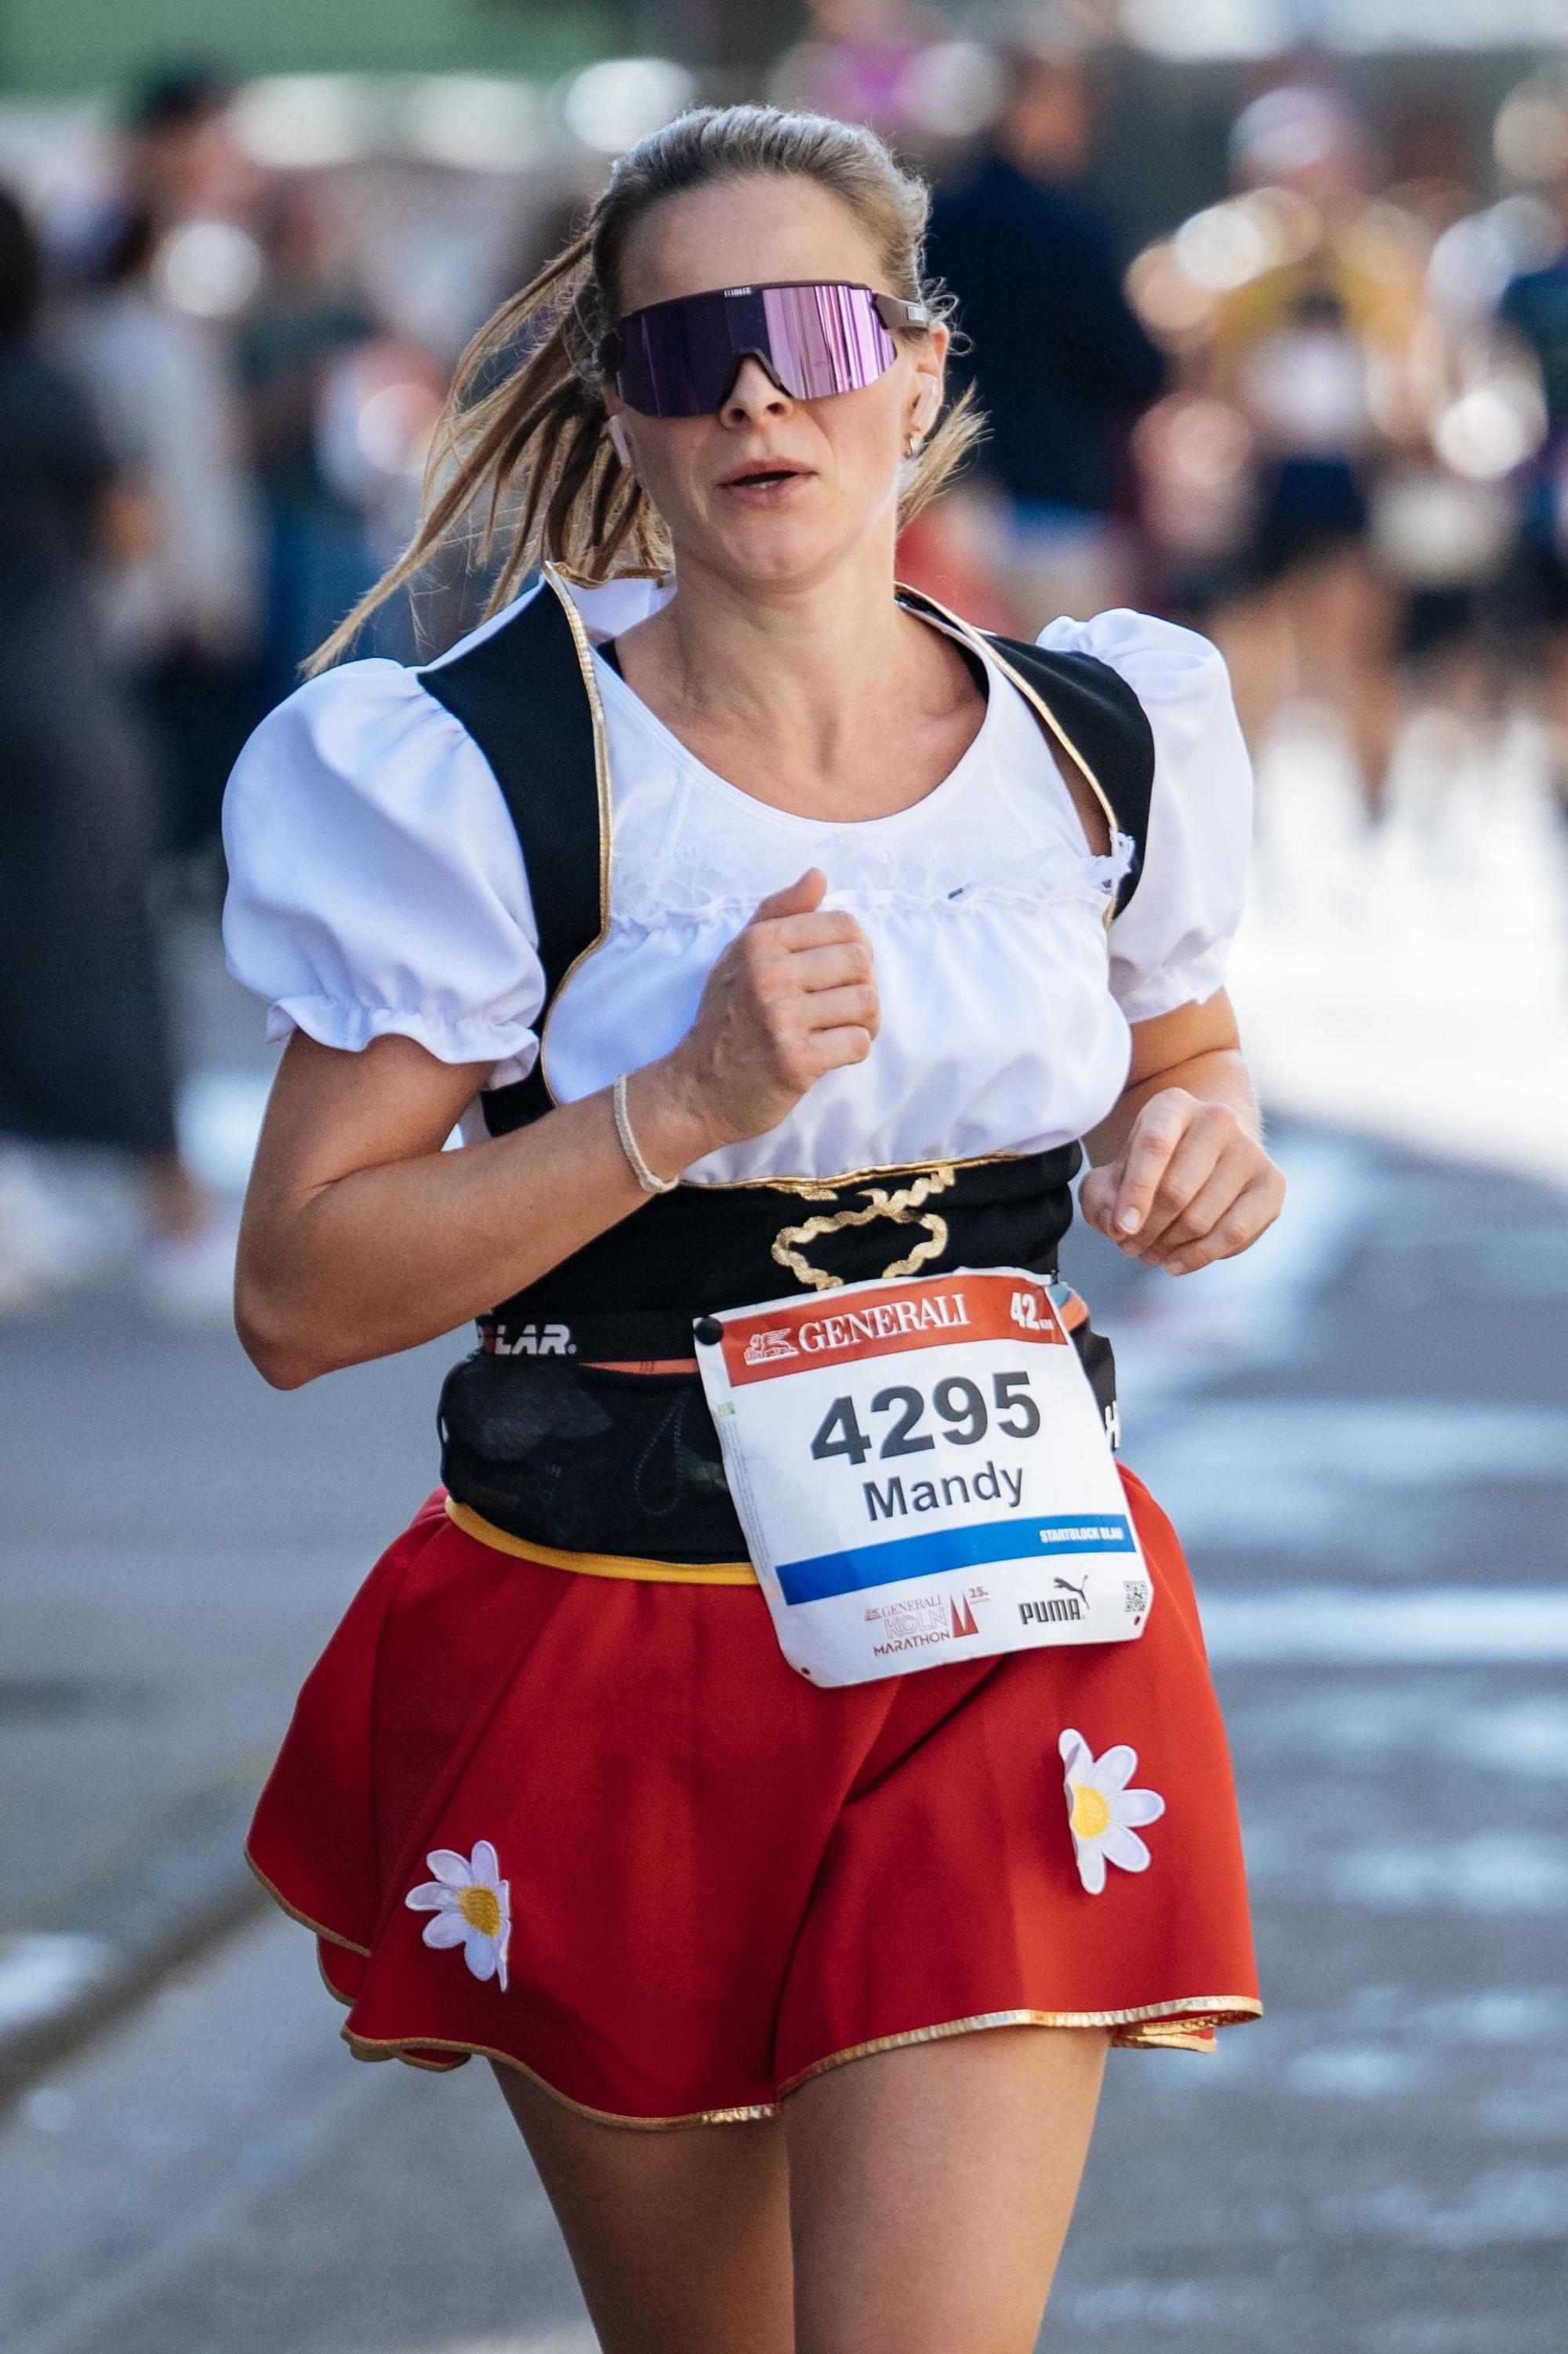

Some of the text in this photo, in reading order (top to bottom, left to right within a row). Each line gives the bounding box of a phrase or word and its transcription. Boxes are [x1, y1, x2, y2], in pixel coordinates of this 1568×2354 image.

[798, 1293, 970, 1354] GENERALI
[1011, 1292, 1040, 1331] 42
[810, 1370, 1041, 1466] 4295
[862, 1459, 1023, 1522] Mandy
[881, 1594, 943, 1618] GENERALI
[1018, 1598, 1081, 1625] PUMA
[873, 1629, 950, 1657] MARATHON
